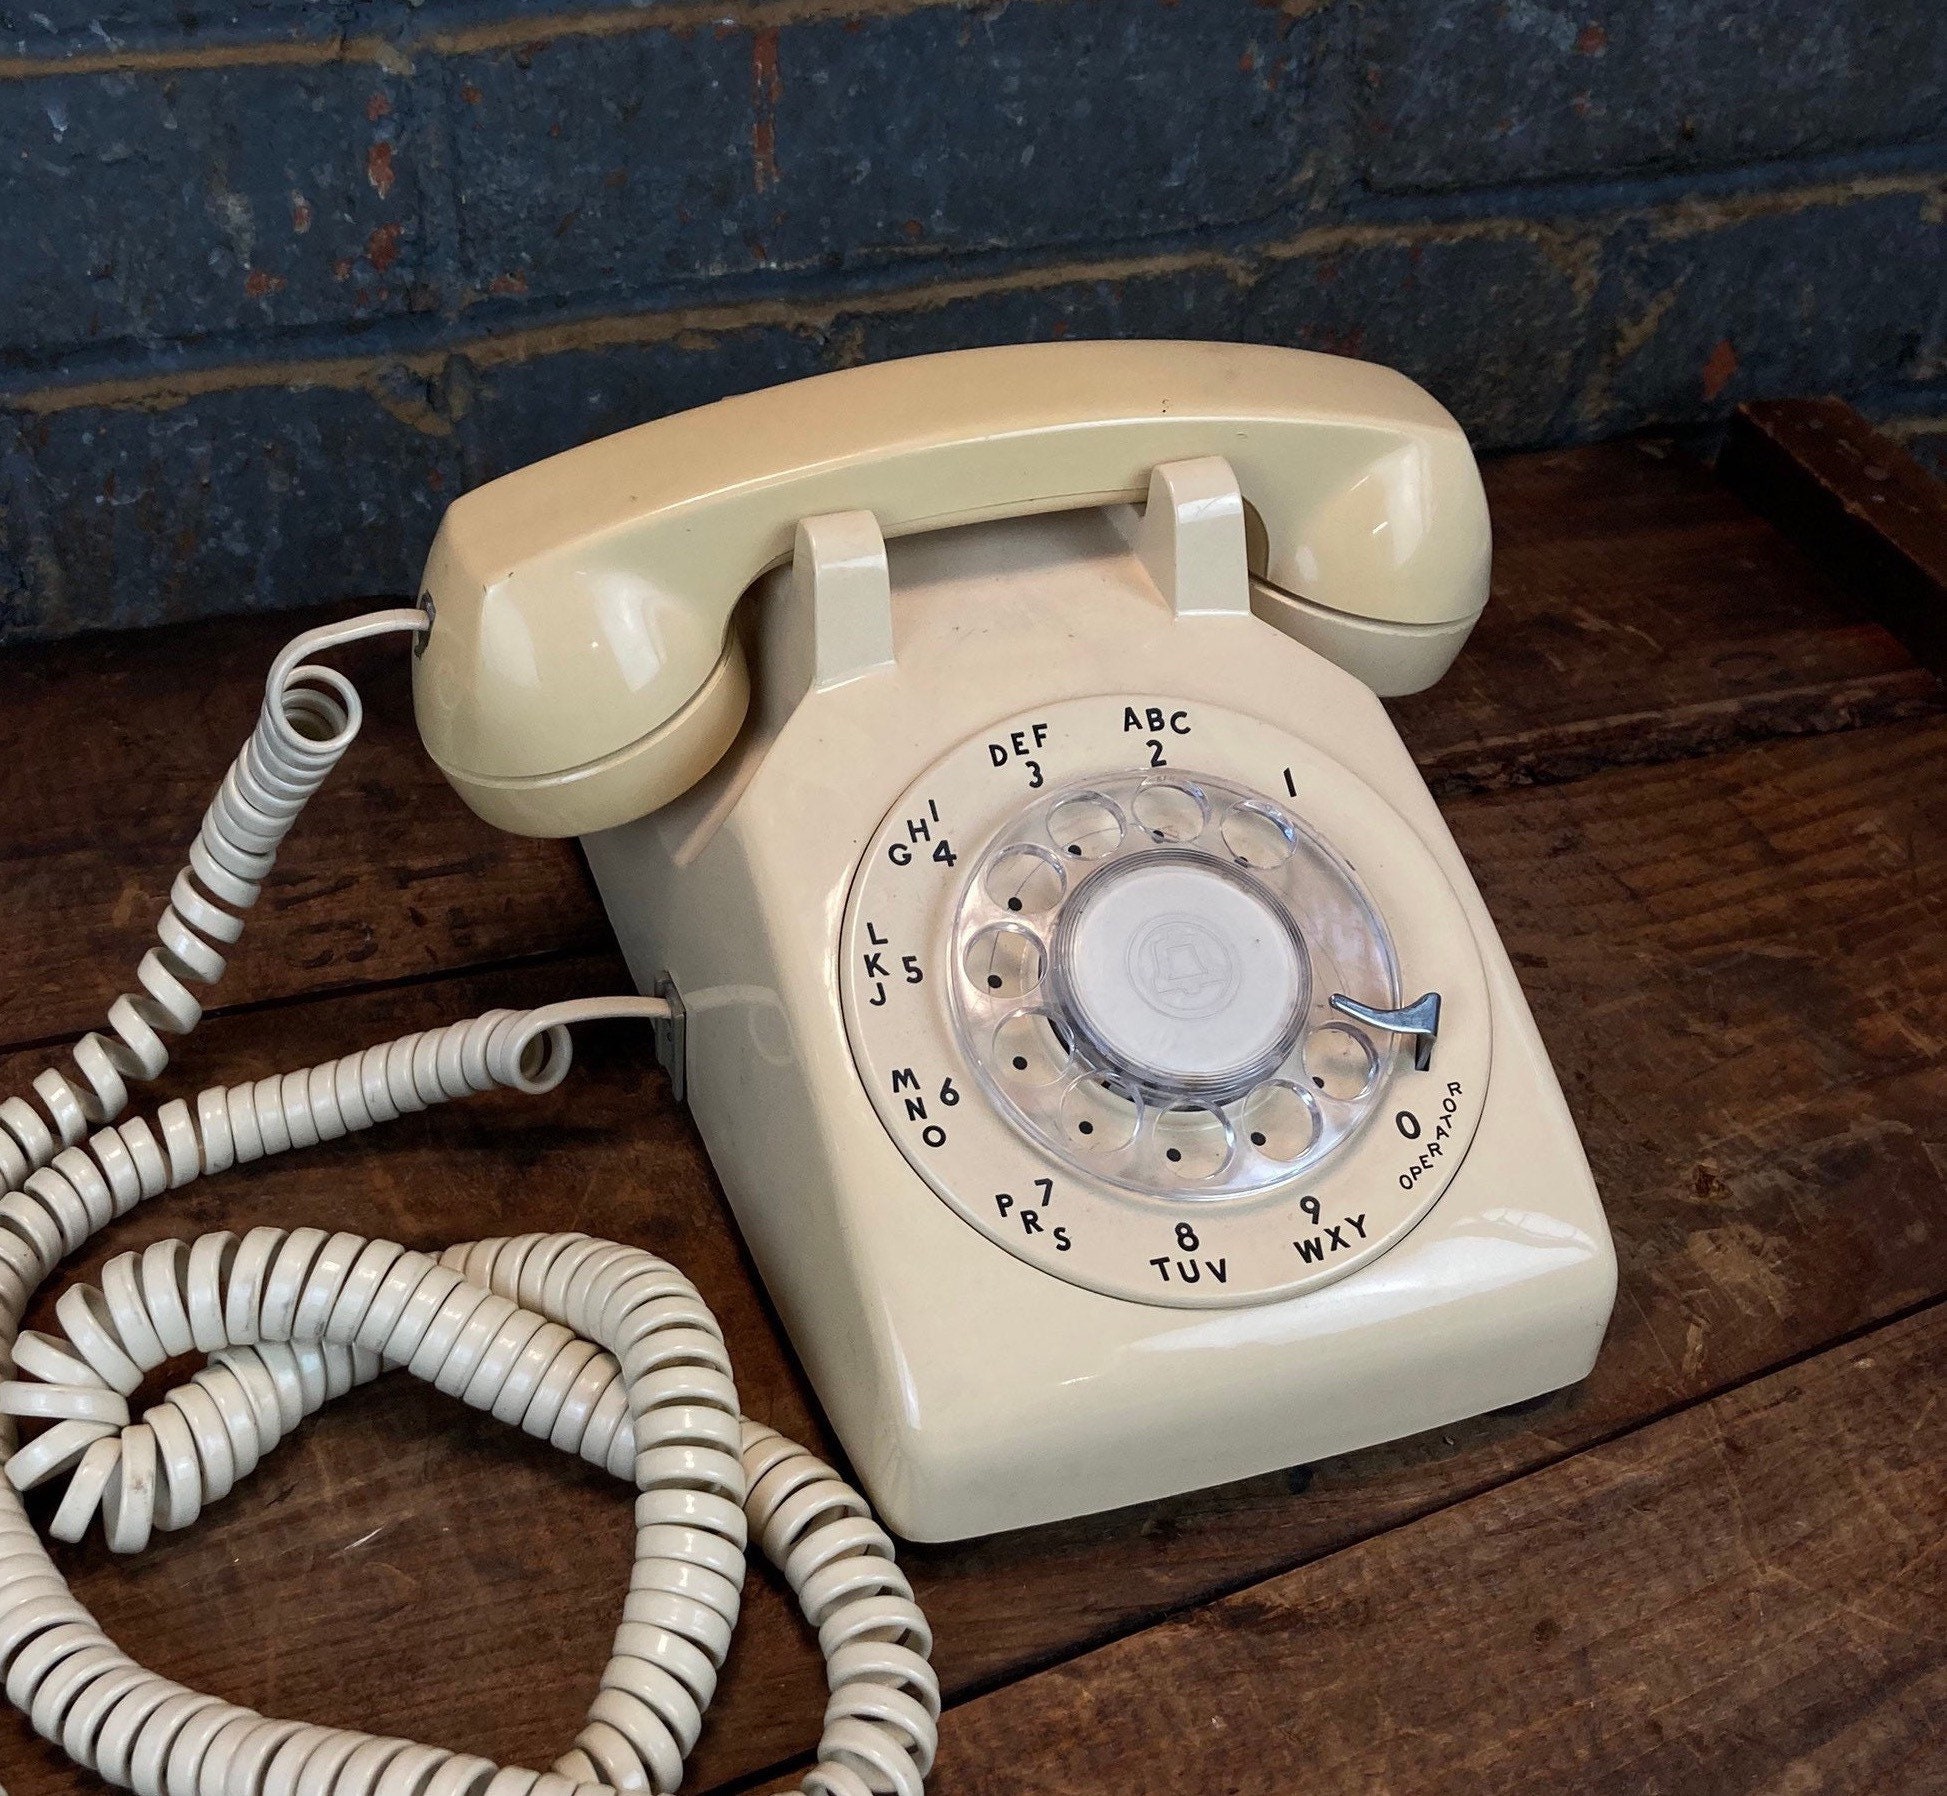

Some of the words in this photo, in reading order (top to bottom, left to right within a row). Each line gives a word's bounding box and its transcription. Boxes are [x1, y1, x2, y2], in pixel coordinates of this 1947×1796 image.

[1122, 705, 1193, 736] ABC
[987, 722, 1049, 769] DEF
[1144, 738, 1168, 769] 2
[1023, 759, 1045, 790] 3
[1282, 766, 1298, 799] 1
[887, 798, 941, 868] GHI
[931, 838, 959, 869] 4
[900, 954, 925, 985] 5
[890, 1066, 948, 1149] MNO
[938, 1075, 961, 1108] 6
[1398, 1080, 1464, 1191] OPERATOR
[1032, 1176, 1055, 1208] 7
[994, 1192, 1073, 1253] PRS
[1298, 1194, 1322, 1226] 9
[1173, 1221, 1201, 1253] 8
[1291, 1212, 1368, 1265] WXY
[1148, 1255, 1228, 1285] TUV
